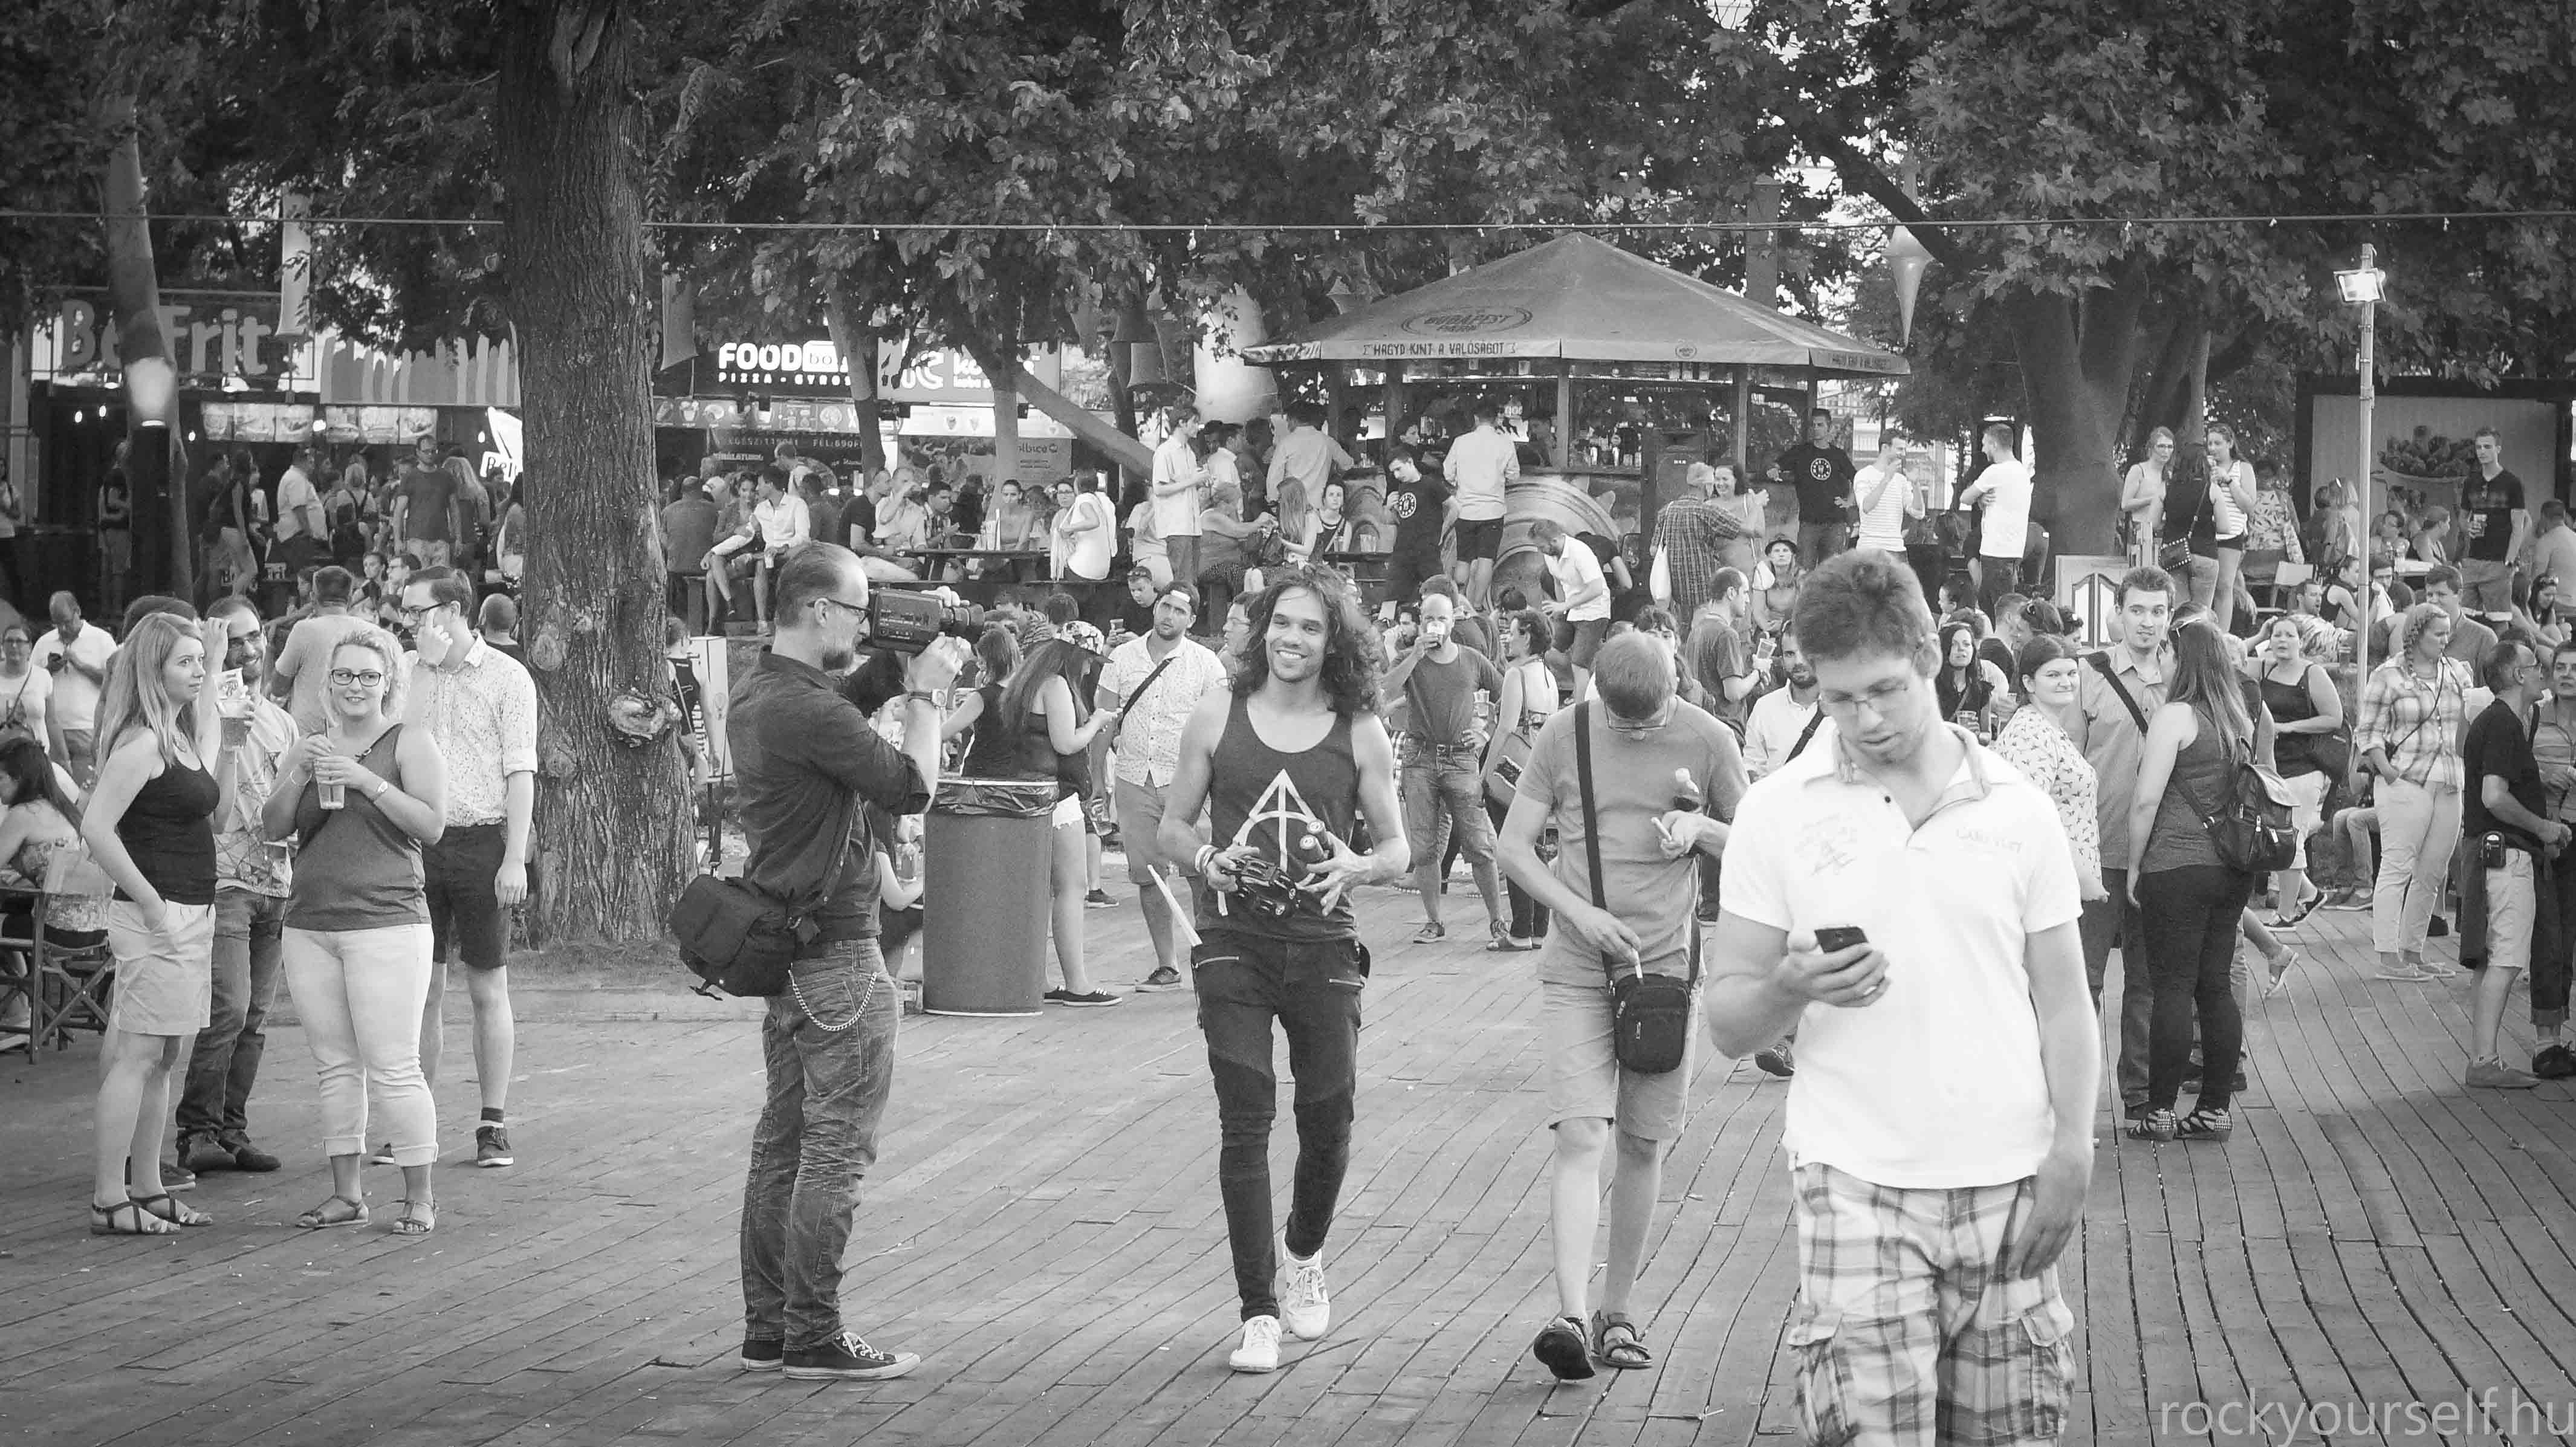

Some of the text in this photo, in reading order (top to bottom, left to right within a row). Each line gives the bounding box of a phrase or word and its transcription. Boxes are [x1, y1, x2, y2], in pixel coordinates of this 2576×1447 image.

[1374, 339, 1505, 355] HAGYD KINT A VALÓSÁGOT
[719, 372, 772, 384] PIZZA
